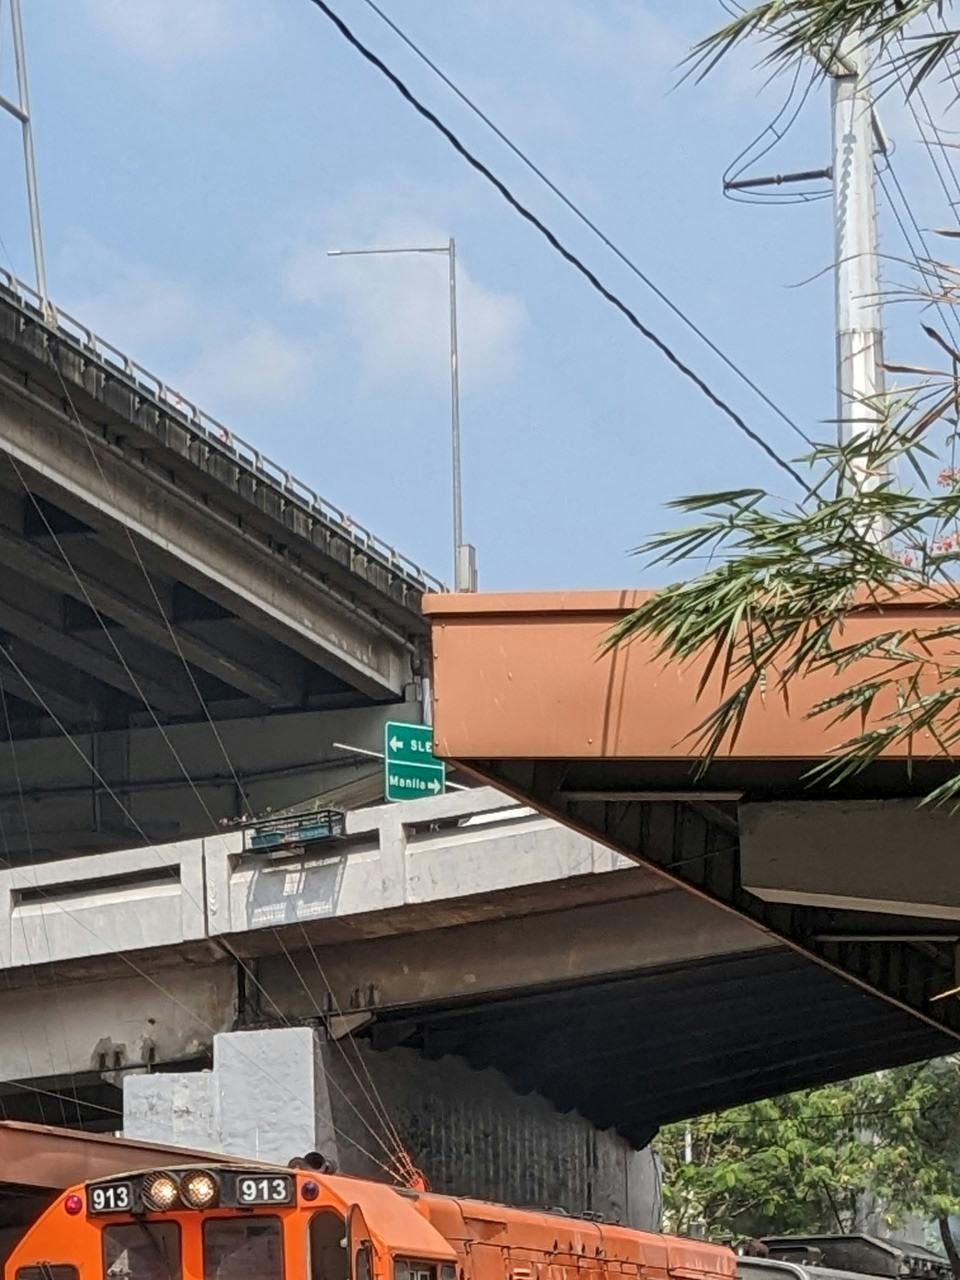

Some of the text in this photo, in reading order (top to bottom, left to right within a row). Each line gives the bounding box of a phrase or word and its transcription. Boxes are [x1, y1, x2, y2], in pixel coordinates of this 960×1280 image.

[390, 775, 426, 790] Manila
[93, 1187, 128, 1209] 913
[242, 1179, 286, 1201] 913
